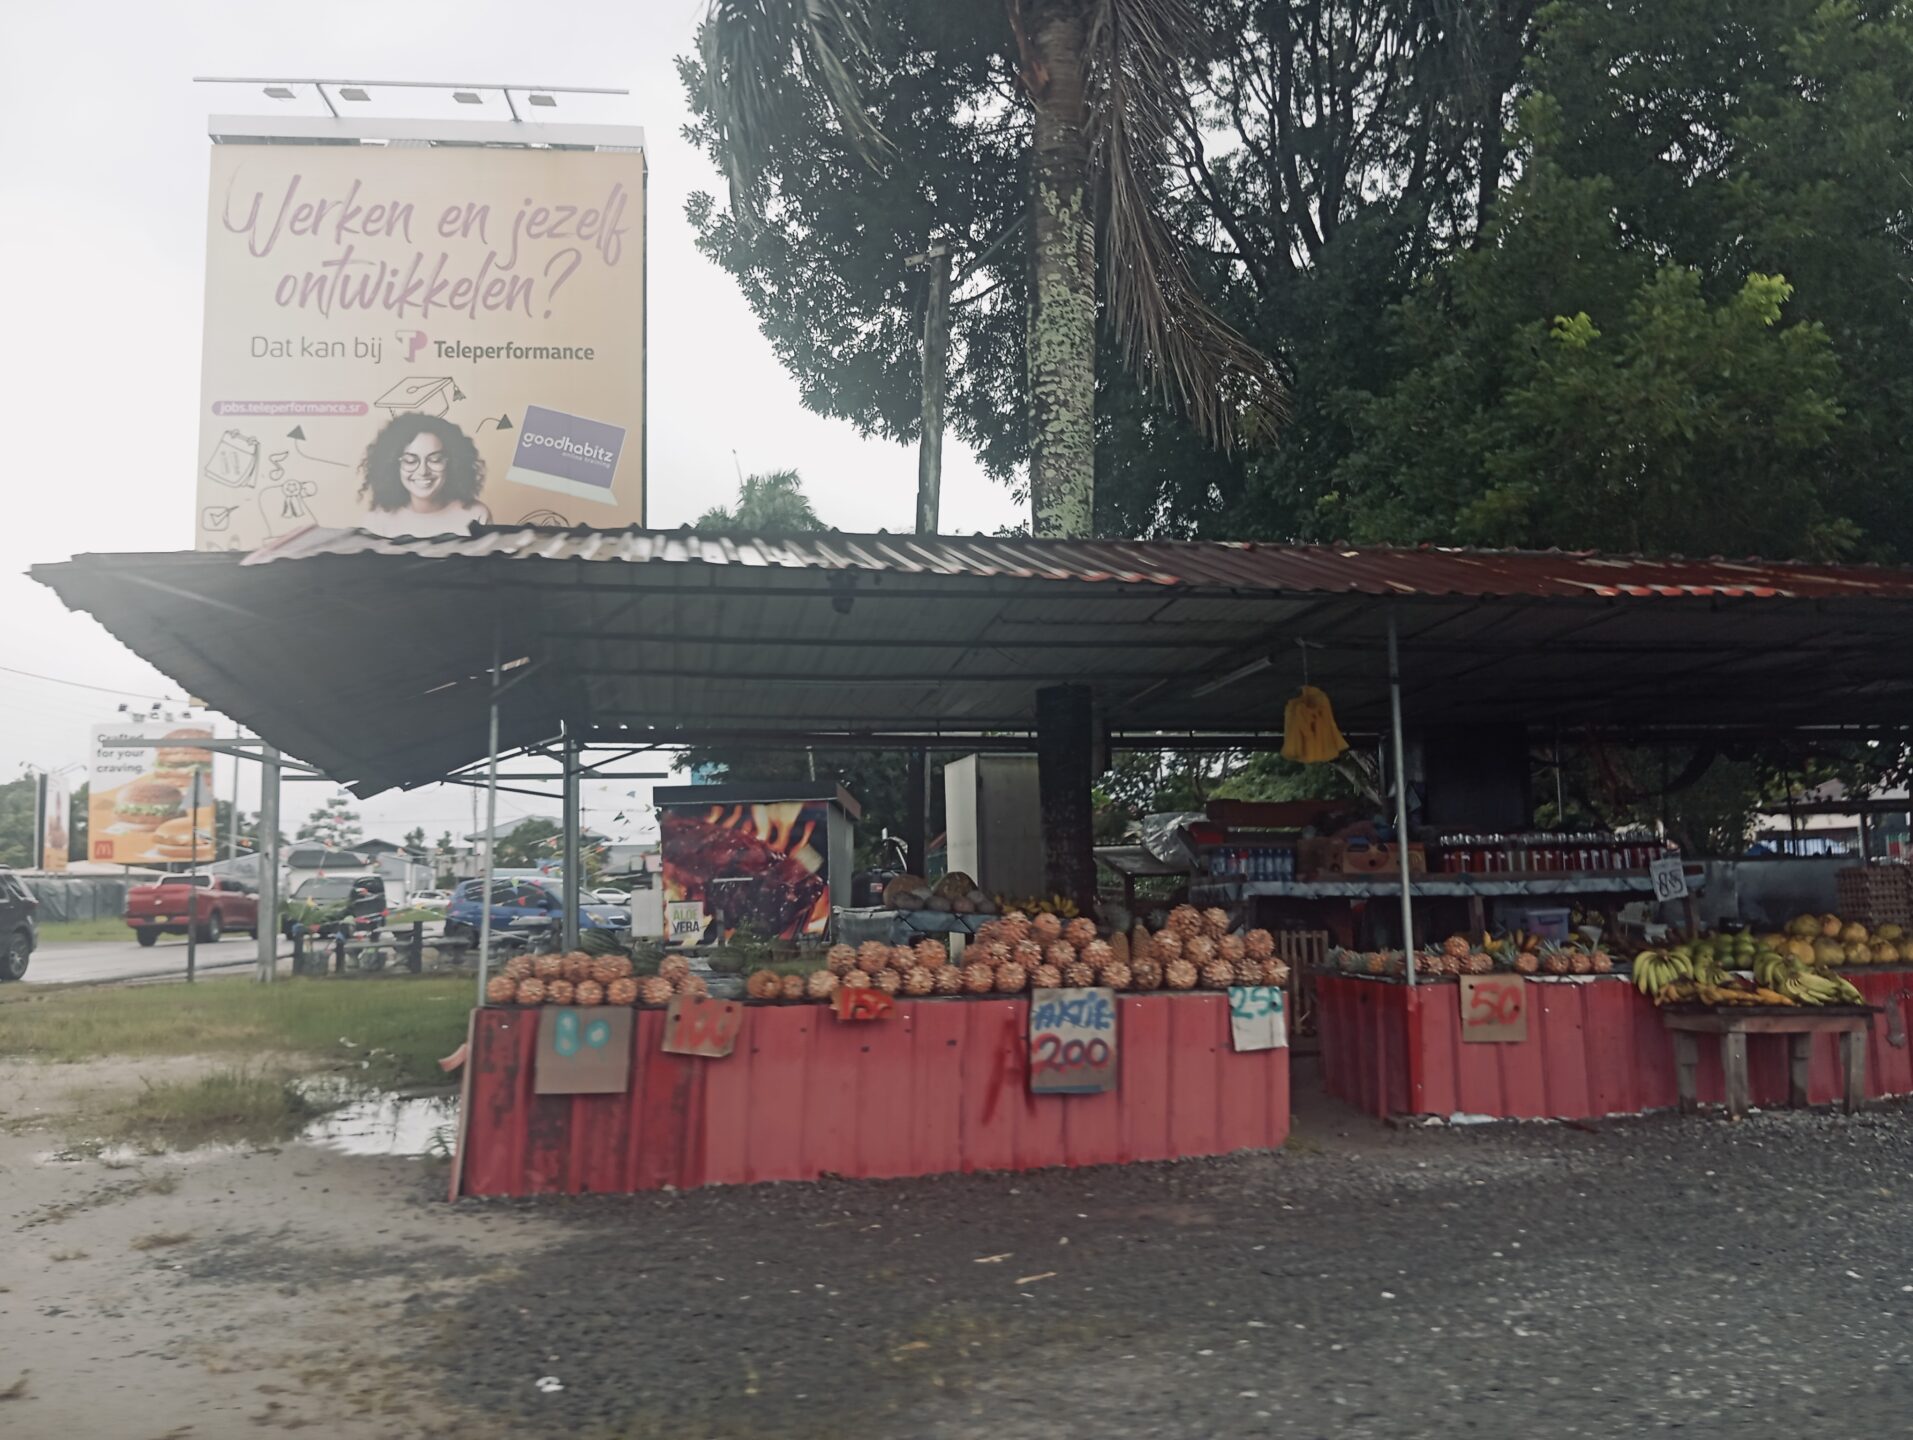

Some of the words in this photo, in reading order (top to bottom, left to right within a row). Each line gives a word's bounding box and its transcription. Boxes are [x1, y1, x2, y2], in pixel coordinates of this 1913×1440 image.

[222, 161, 413, 258] Werken
[437, 200, 489, 245] en
[494, 182, 630, 272] jezelf
[274, 245, 583, 320] ontwikkelen?
[250, 336, 293, 359] Dat
[301, 335, 346, 359] kan
[354, 336, 383, 364] bij
[434, 340, 595, 361] Teleperformance
[219, 401, 361, 415] jobs.teleperformance.sr
[522, 432, 614, 463] goodhabitz
[97, 749, 114, 758] for
[117, 749, 145, 761] your
[672, 920, 700, 934] VERA
[1229, 986, 1283, 1019] 250
[1468, 982, 1521, 1028] 50
[554, 1009, 611, 1057] 80
[1032, 1033, 1110, 1074] 200
